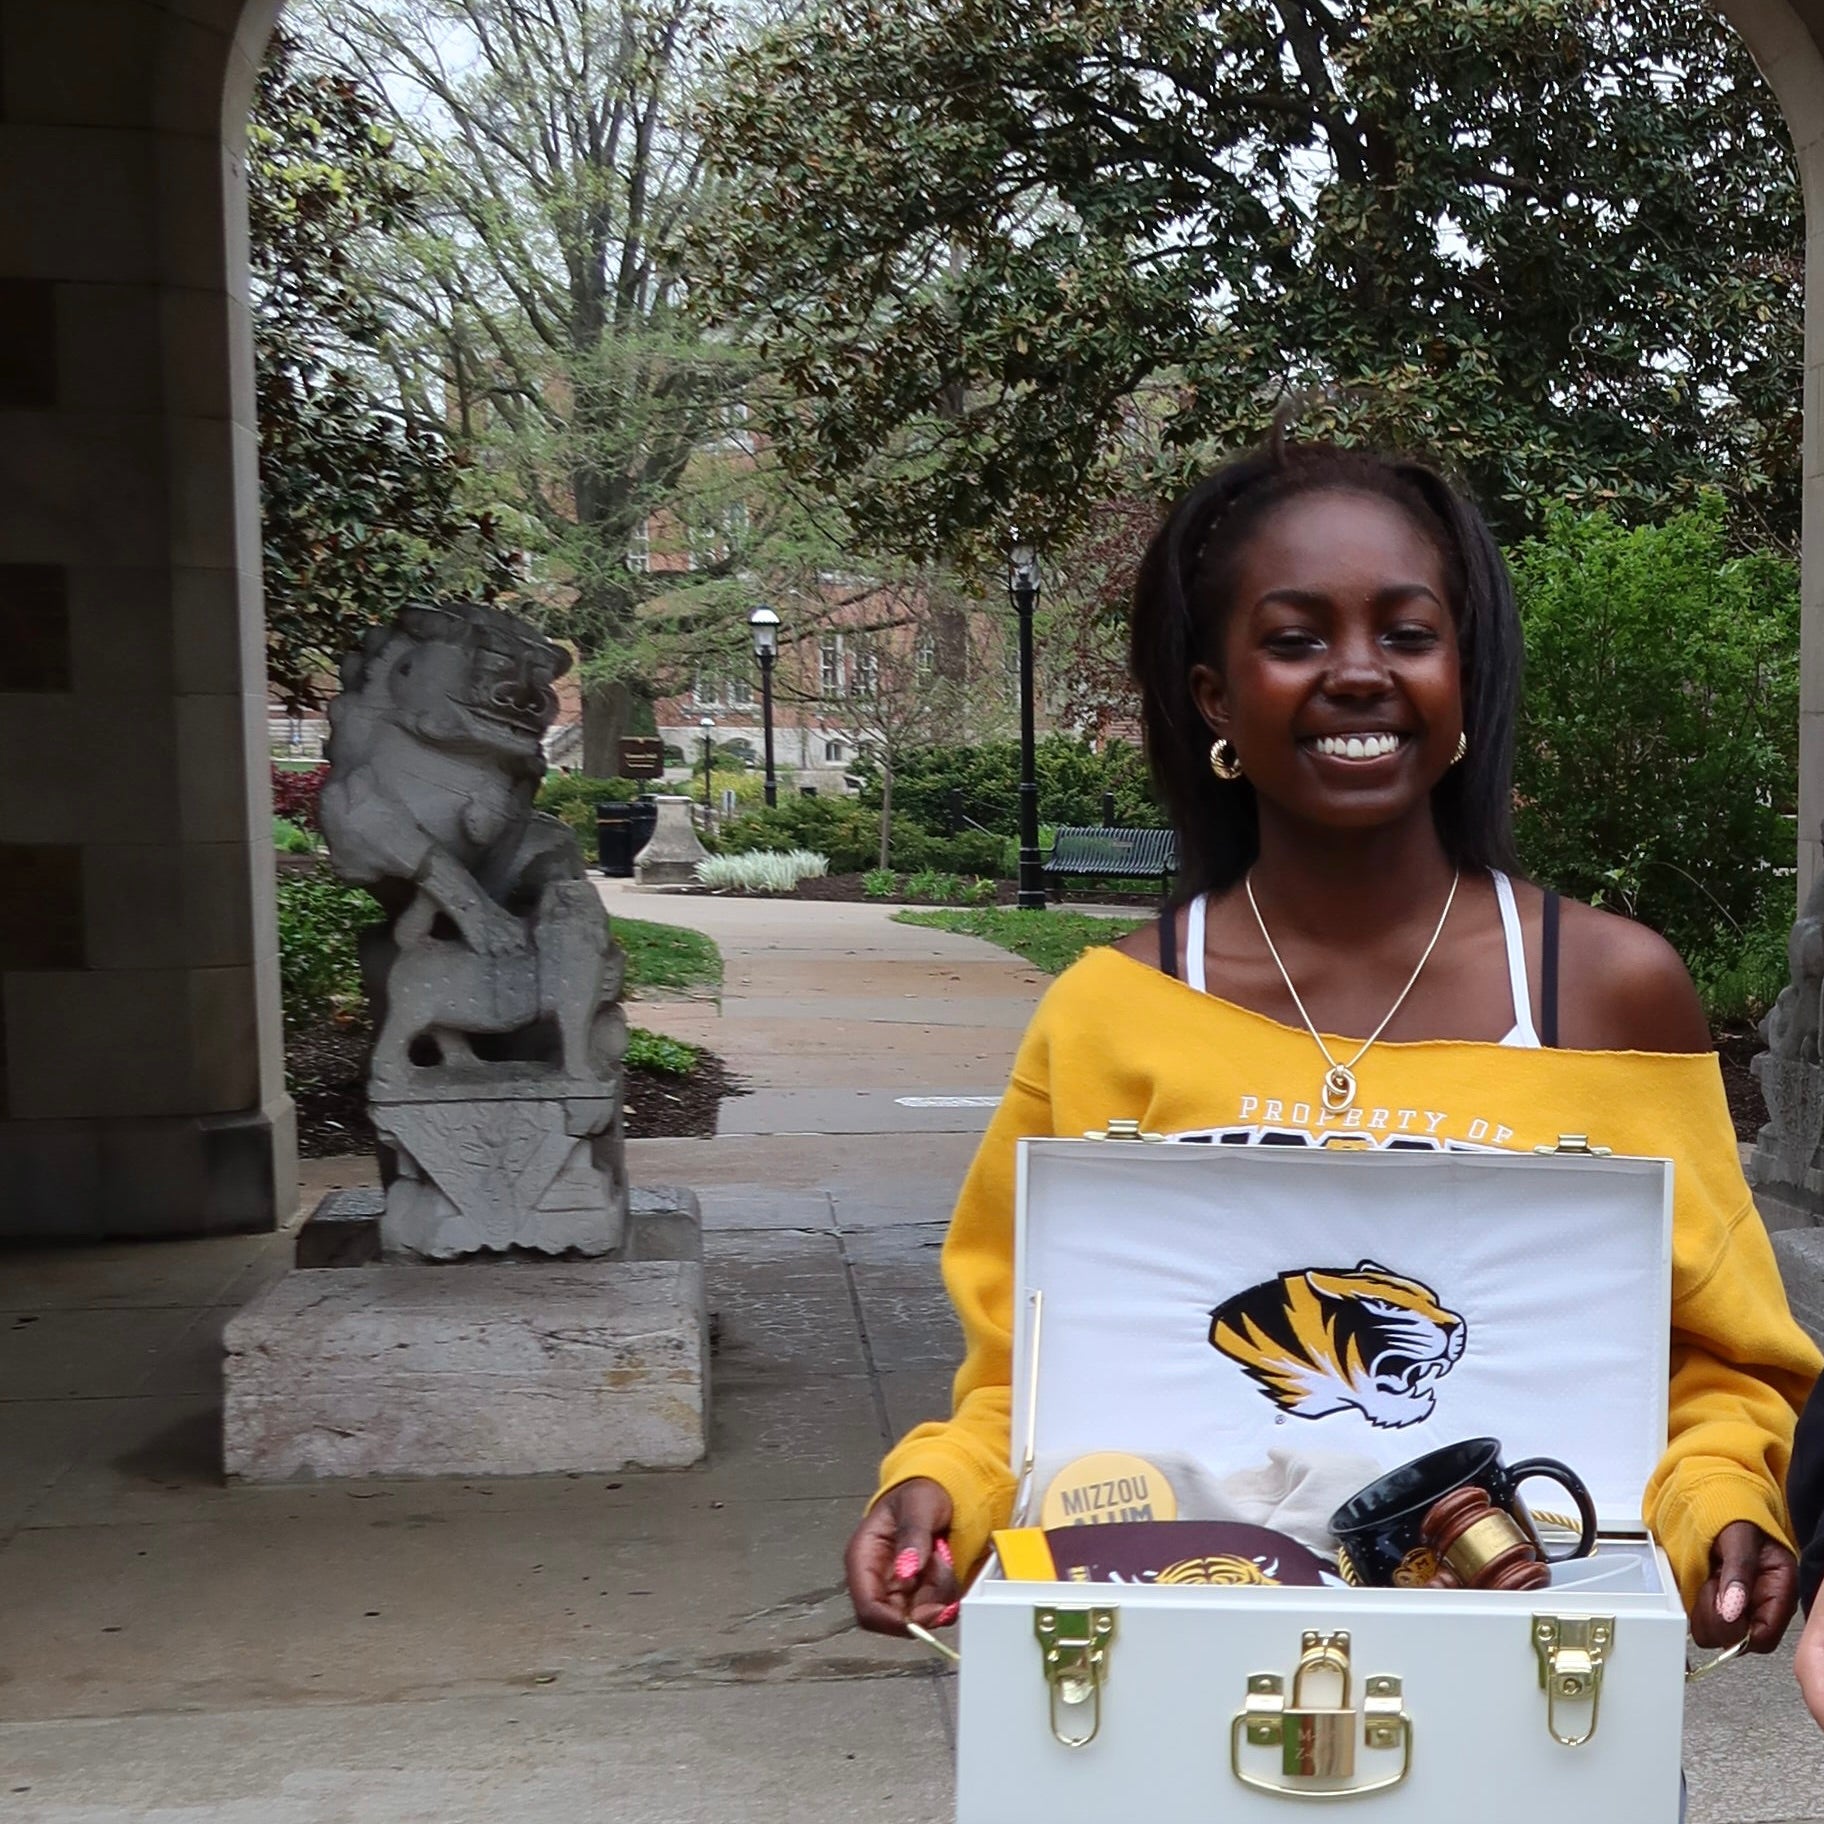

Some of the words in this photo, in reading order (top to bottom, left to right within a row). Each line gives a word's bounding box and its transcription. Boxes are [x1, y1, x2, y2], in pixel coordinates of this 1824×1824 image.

[1239, 1095, 1448, 1133] PROPERTY
[1467, 1118, 1514, 1144] OF
[1061, 1475, 1149, 1516] MIZZOU
